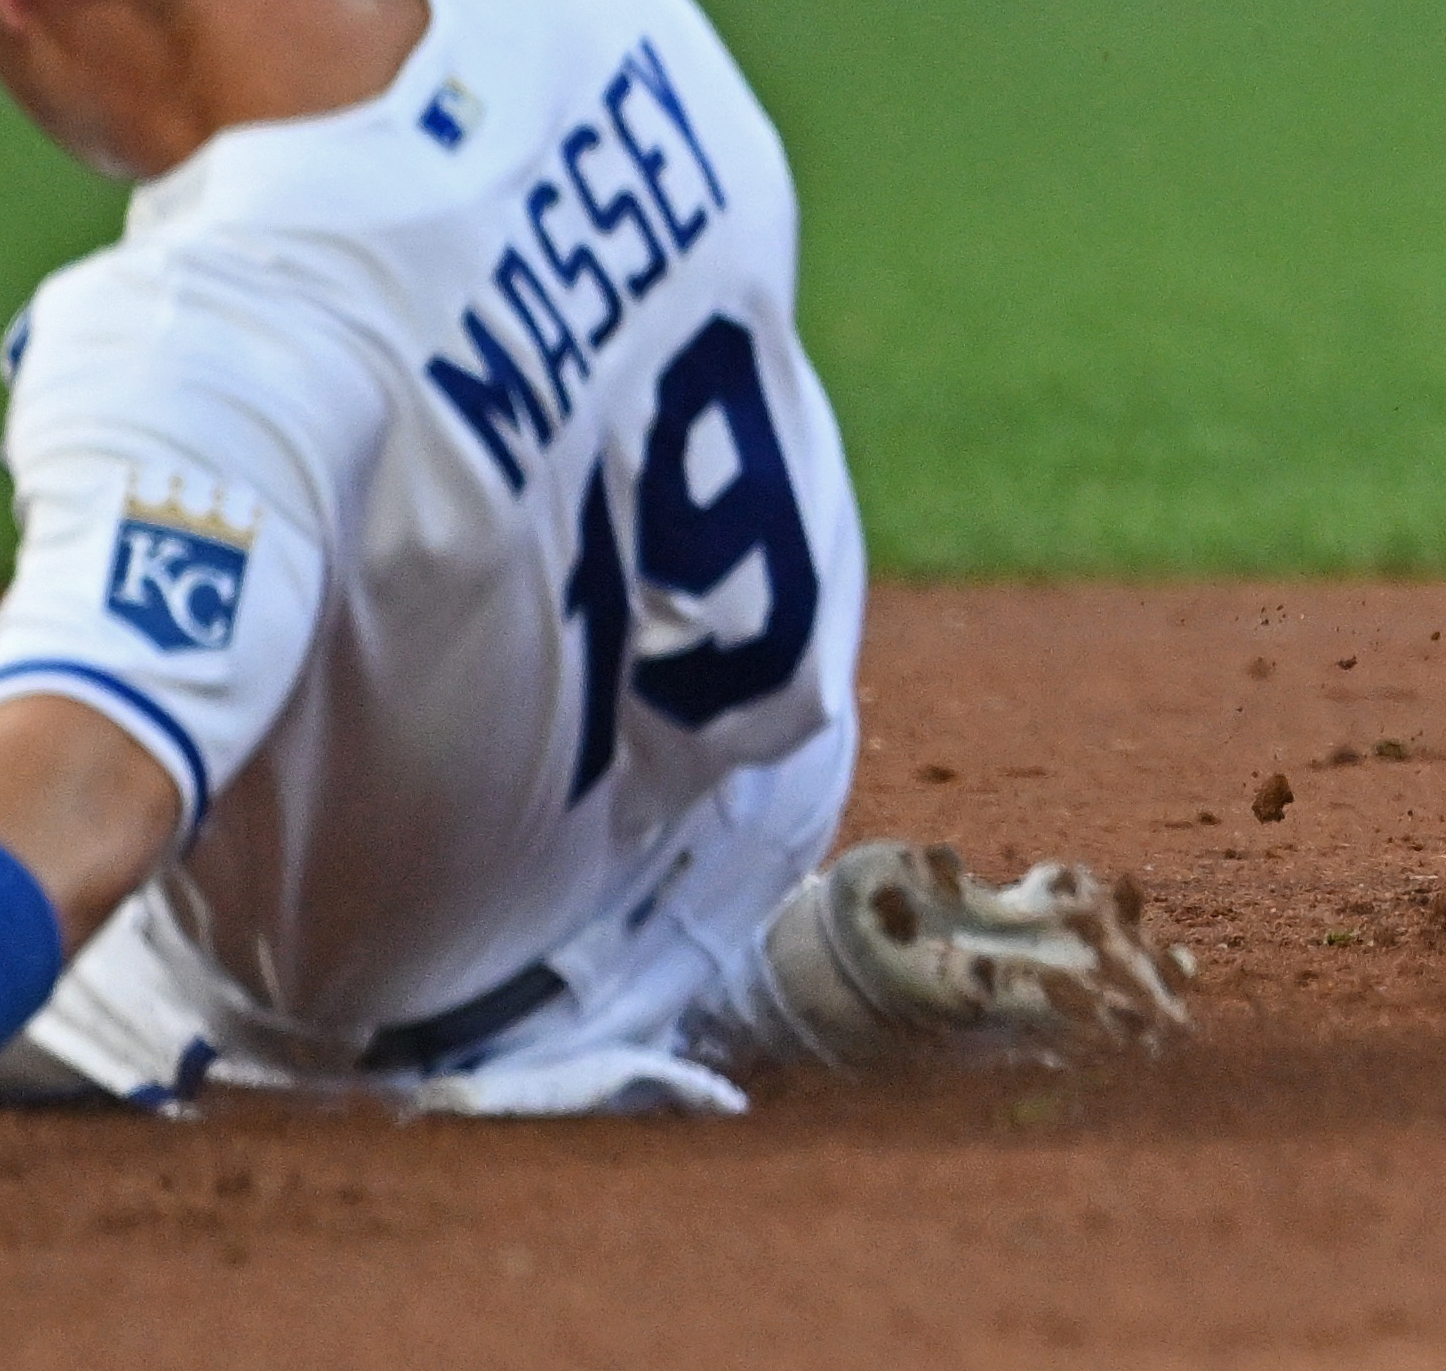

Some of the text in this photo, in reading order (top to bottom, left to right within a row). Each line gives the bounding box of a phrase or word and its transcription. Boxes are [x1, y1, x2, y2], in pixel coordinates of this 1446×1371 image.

[424, 35, 728, 500] MASSEY
[116, 530, 236, 649] KC
[562, 310, 820, 814] 19
